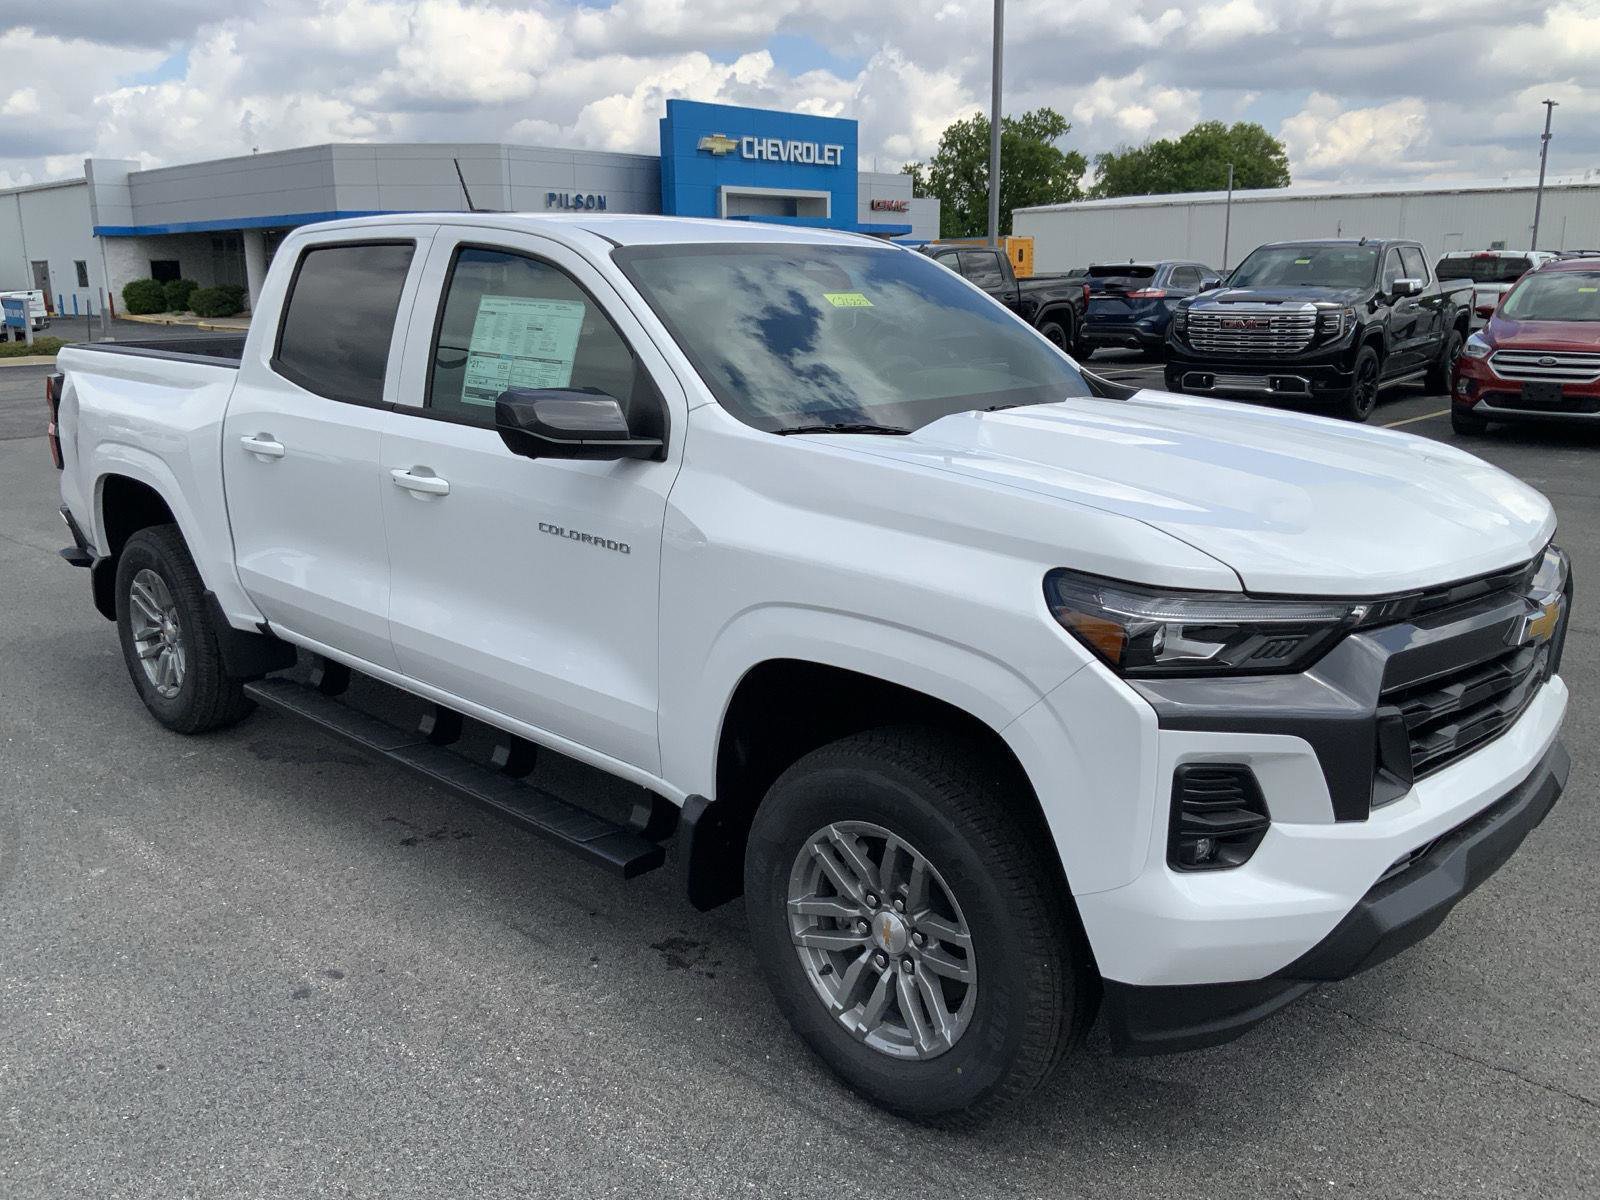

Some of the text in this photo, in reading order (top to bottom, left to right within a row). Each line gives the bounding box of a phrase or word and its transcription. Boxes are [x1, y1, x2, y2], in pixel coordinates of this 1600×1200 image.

[741, 136, 844, 166] CHEVROLET
[546, 192, 607, 210] PILSON
[1222, 319, 1269, 330] GMC
[538, 522, 631, 554] COLORADO
